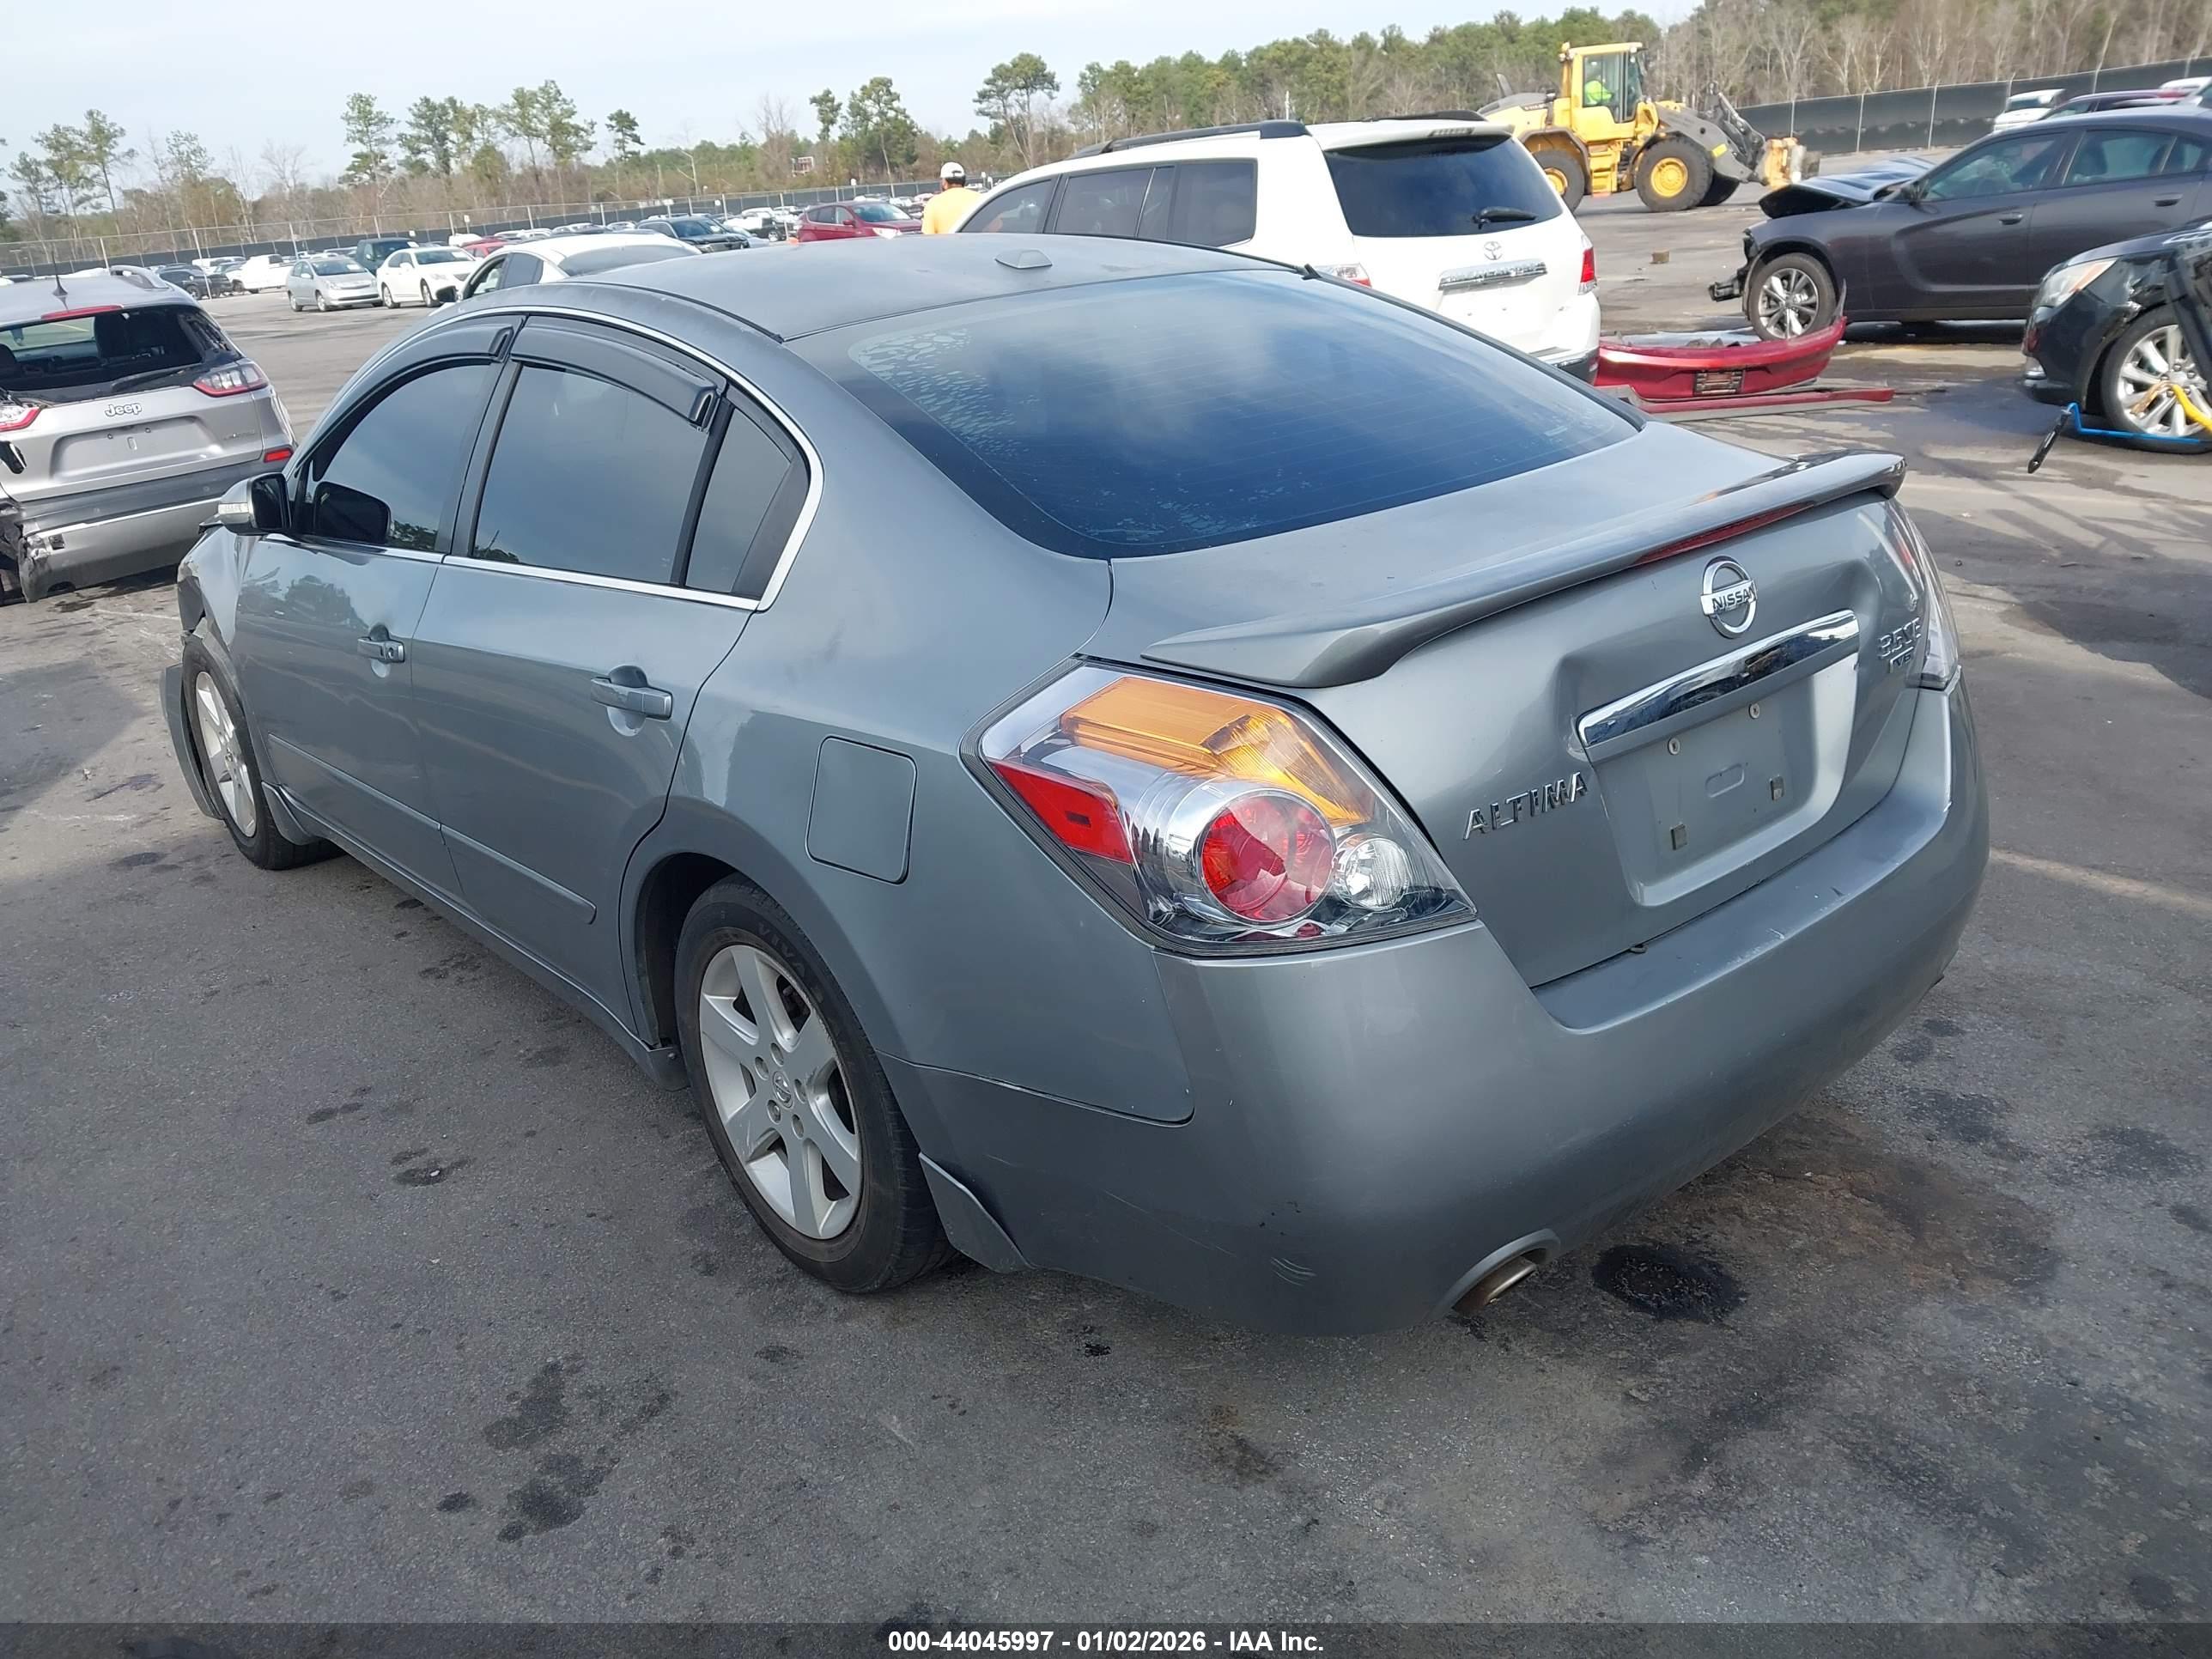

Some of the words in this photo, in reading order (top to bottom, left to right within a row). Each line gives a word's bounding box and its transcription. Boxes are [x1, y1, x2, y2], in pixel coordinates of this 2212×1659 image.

[105, 402, 142, 417] Jeep
[1711, 580, 1756, 610] NISSAN
[1462, 771, 1588, 841] ALTIMA
